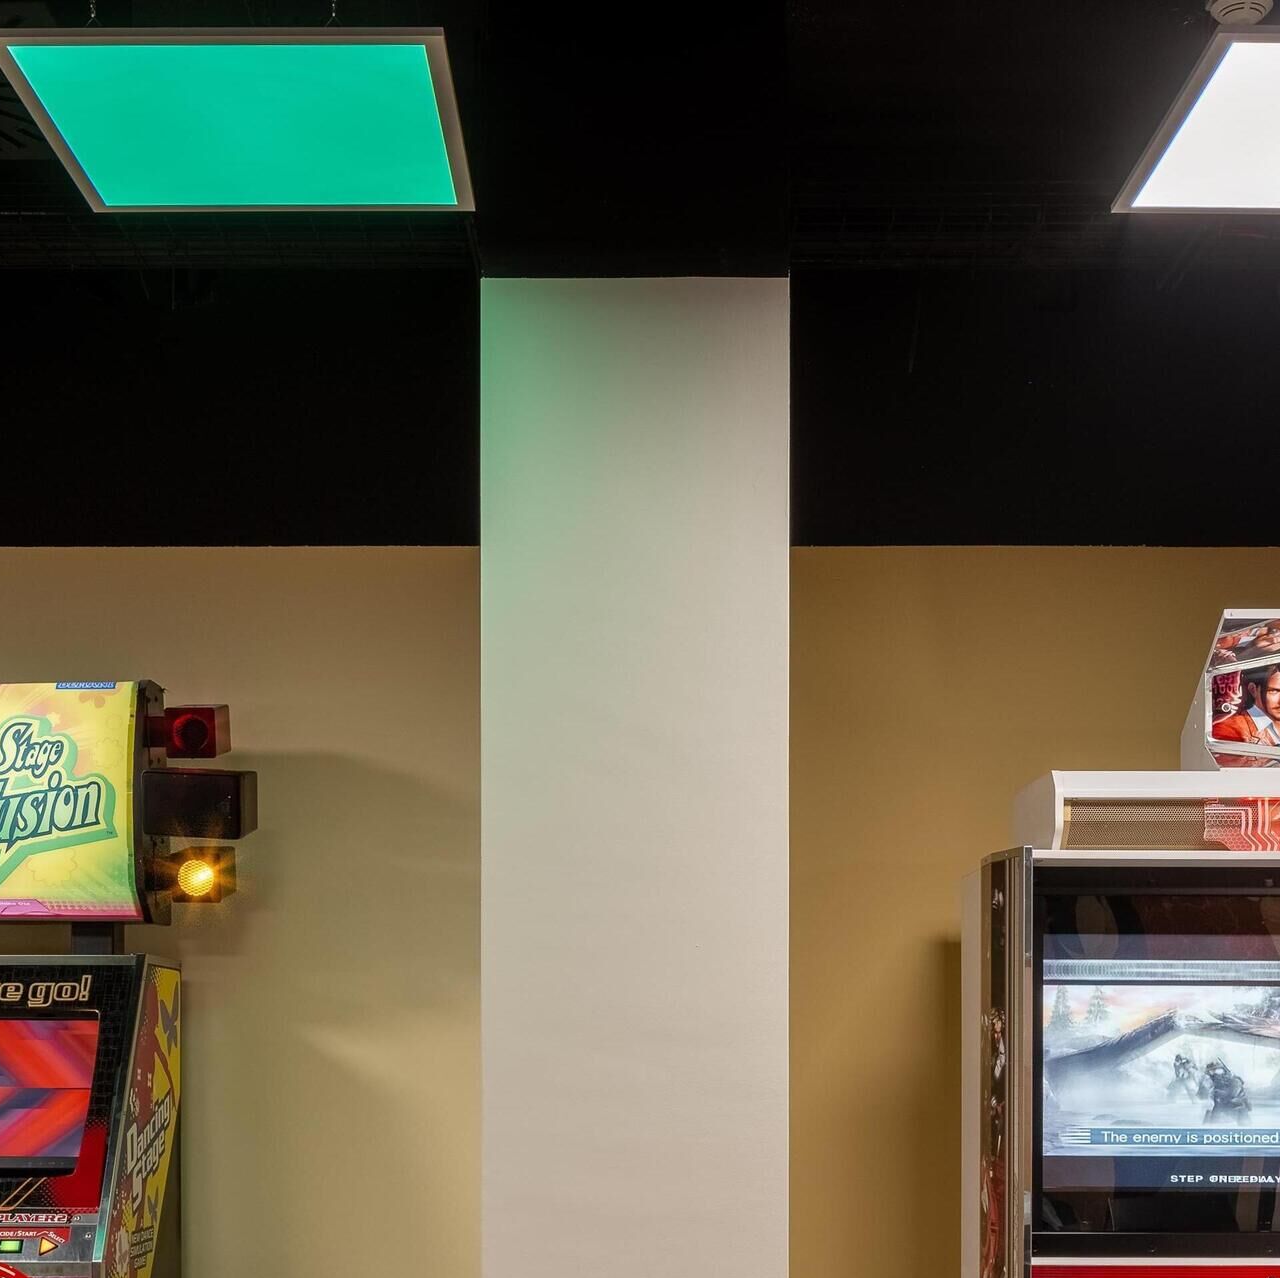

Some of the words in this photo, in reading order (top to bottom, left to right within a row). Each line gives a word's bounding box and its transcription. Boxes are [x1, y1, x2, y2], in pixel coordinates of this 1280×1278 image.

[27, 975, 92, 1008] go!
[126, 1094, 171, 1175] Dancing
[1101, 1130, 1128, 1144] The
[1133, 1134, 1180, 1147] enemy
[1187, 1130, 1198, 1144] is
[1203, 1130, 1279, 1147] positioned
[131, 1130, 166, 1212] Stage
[1170, 1174, 1203, 1183] STEP
[47, 1230, 66, 1244] SELECT
